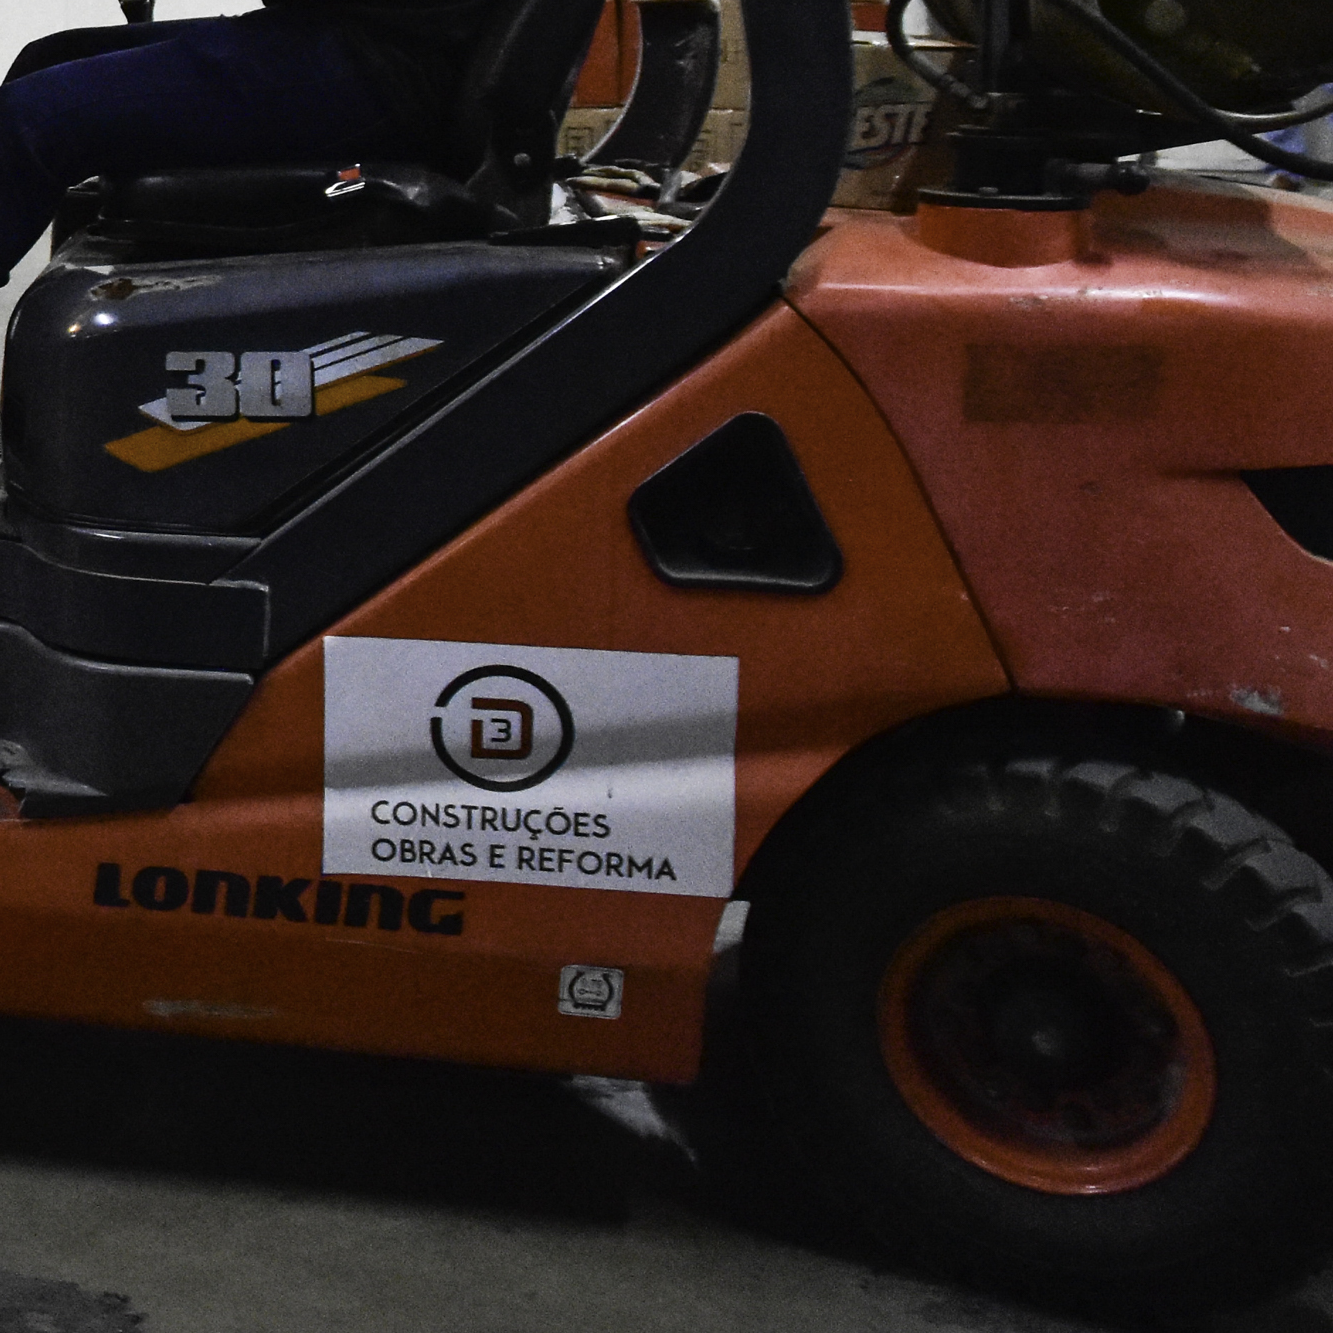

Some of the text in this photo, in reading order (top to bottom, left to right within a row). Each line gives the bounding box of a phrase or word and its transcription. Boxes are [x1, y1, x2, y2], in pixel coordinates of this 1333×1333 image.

[165, 351, 316, 421] 30
[371, 800, 611, 840] CONSTRUÇÕES
[371, 838, 678, 882] OBRAS E REFORMA
[93, 862, 466, 936] LONKING
